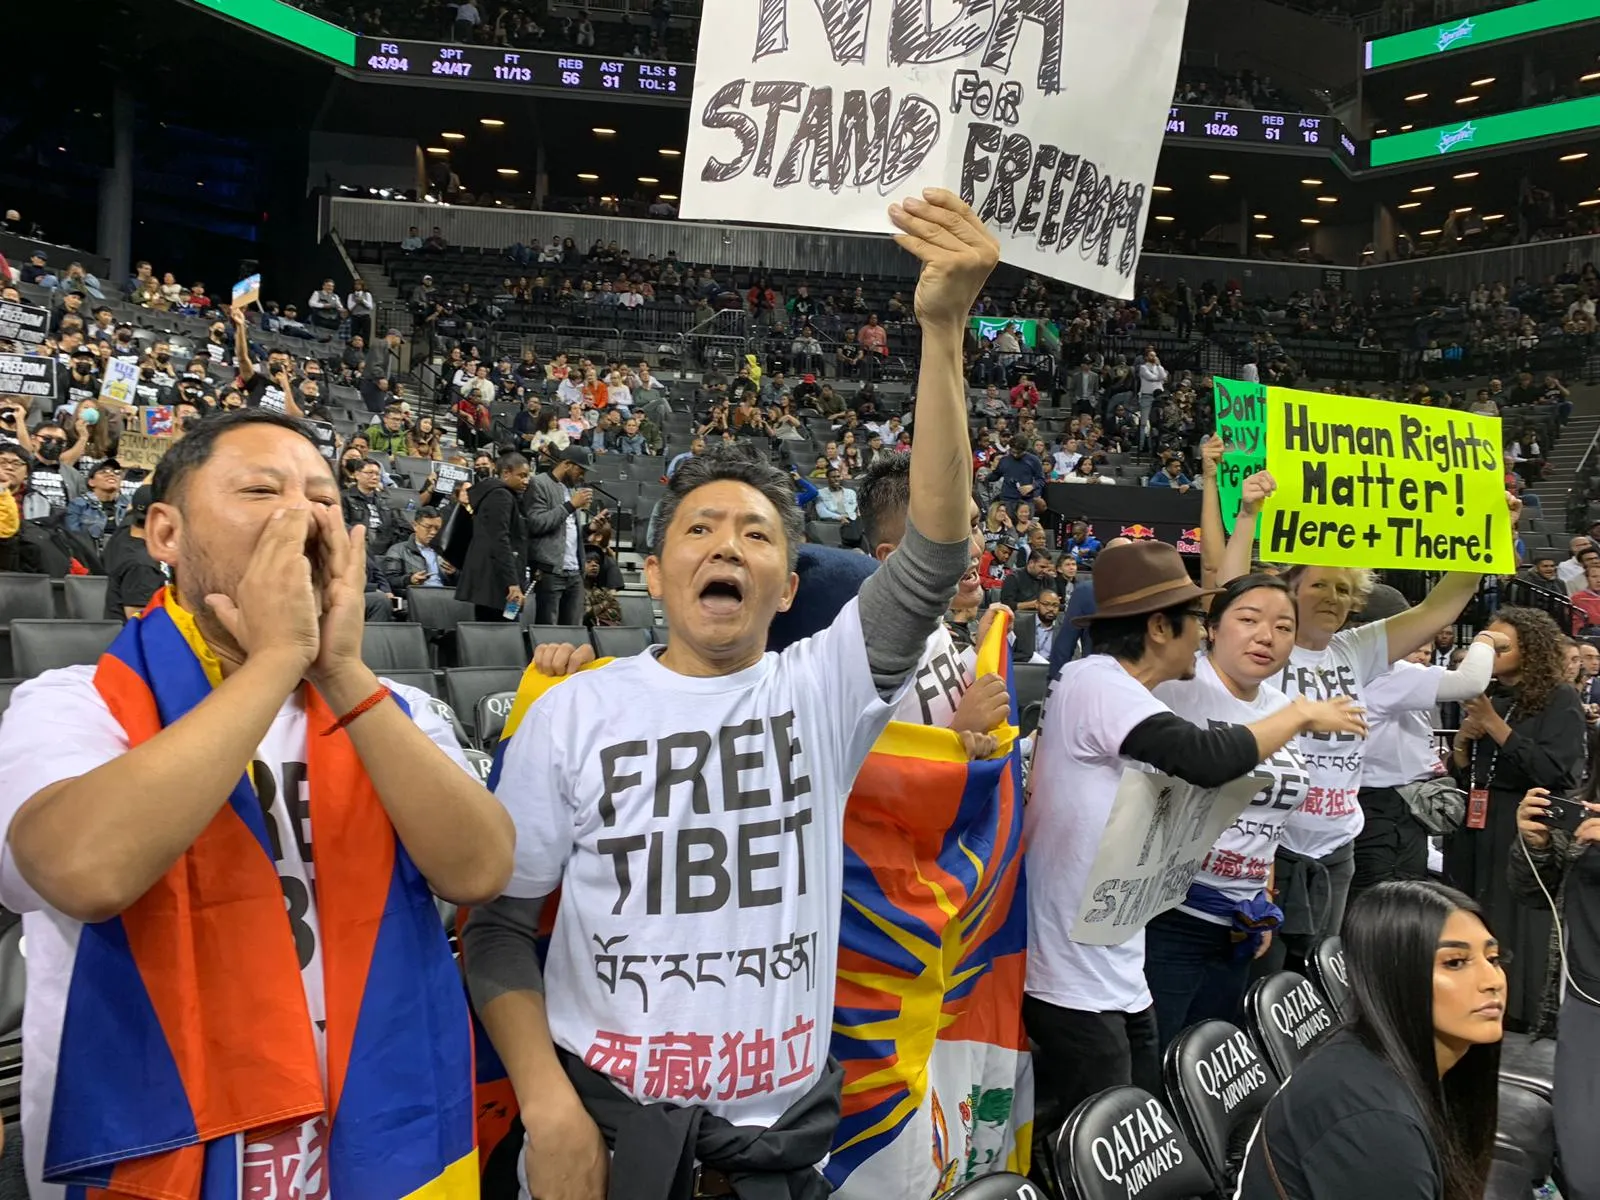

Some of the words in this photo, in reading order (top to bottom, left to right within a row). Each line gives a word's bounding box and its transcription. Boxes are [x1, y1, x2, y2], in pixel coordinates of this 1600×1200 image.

[368, 55, 408, 71] 43/94
[432, 60, 472, 76] 24/47
[493, 66, 531, 81] 11/13
[562, 72, 580, 85] 56
[603, 75, 620, 88] 31
[638, 78, 665, 90] TOL:
[668, 81, 676, 91] 2
[380, 43, 399, 54] FG
[440, 49, 464, 60] 3PT
[504, 54, 520, 64] FT
[558, 58, 583, 70] REB
[600, 62, 624, 73] AST
[640, 65, 665, 76] FLS:
[701, 79, 940, 194] STAND
[950, 69, 1023, 125] FOR
[1166, 120, 1185, 133] /41
[1204, 122, 1238, 136] 18/26
[1265, 128, 1280, 140] 51
[1303, 131, 1318, 143] 16
[1215, 112, 1228, 121] FT
[1262, 115, 1284, 126] REB
[1298, 119, 1320, 128] AST
[960, 122, 1145, 278] FREEDOM
[1284, 402, 1394, 458] Human
[1400, 414, 1497, 473] Rights
[1302, 460, 1466, 517] Matter!
[1270, 509, 1355, 553] Here
[1387, 514, 1493, 564] There!
[914, 642, 975, 725] FRE
[599, 710, 811, 827] FREE
[597, 807, 812, 915] TIBET
[1270, 979, 1322, 1038] QATAR
[1293, 1007, 1331, 1050] AIRWAYS
[584, 1015, 815, 1101] 西藏独立
[1195, 1030, 1257, 1099] QATAR
[1221, 1063, 1267, 1114] AIRWAYS
[1091, 1098, 1173, 1184] QATAR
[1124, 1138, 1184, 1199] AIRWAYS
